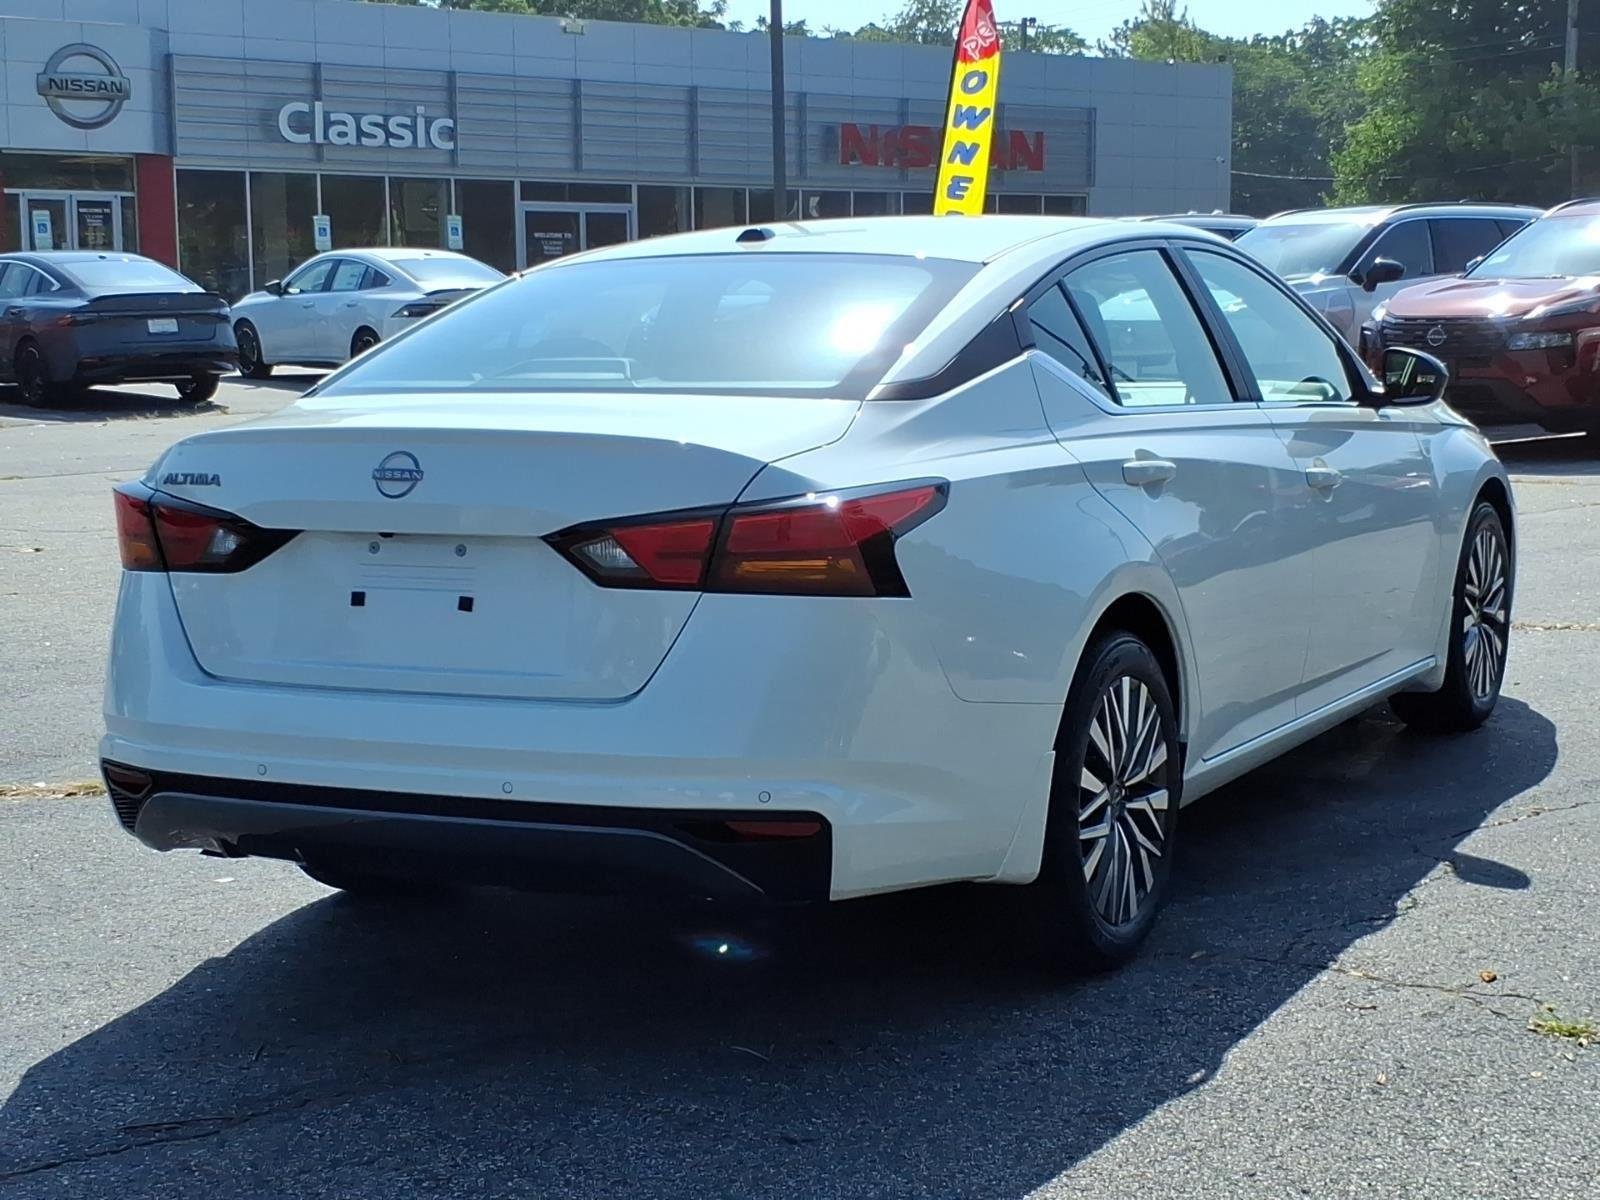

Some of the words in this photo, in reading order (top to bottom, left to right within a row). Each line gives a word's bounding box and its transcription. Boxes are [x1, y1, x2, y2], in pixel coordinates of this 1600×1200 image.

[48, 77, 123, 94] NISSAN
[278, 101, 454, 150] Classic
[946, 69, 991, 215] OWNE
[163, 472, 222, 488] ALTIMA
[373, 469, 424, 481] NISSAN
